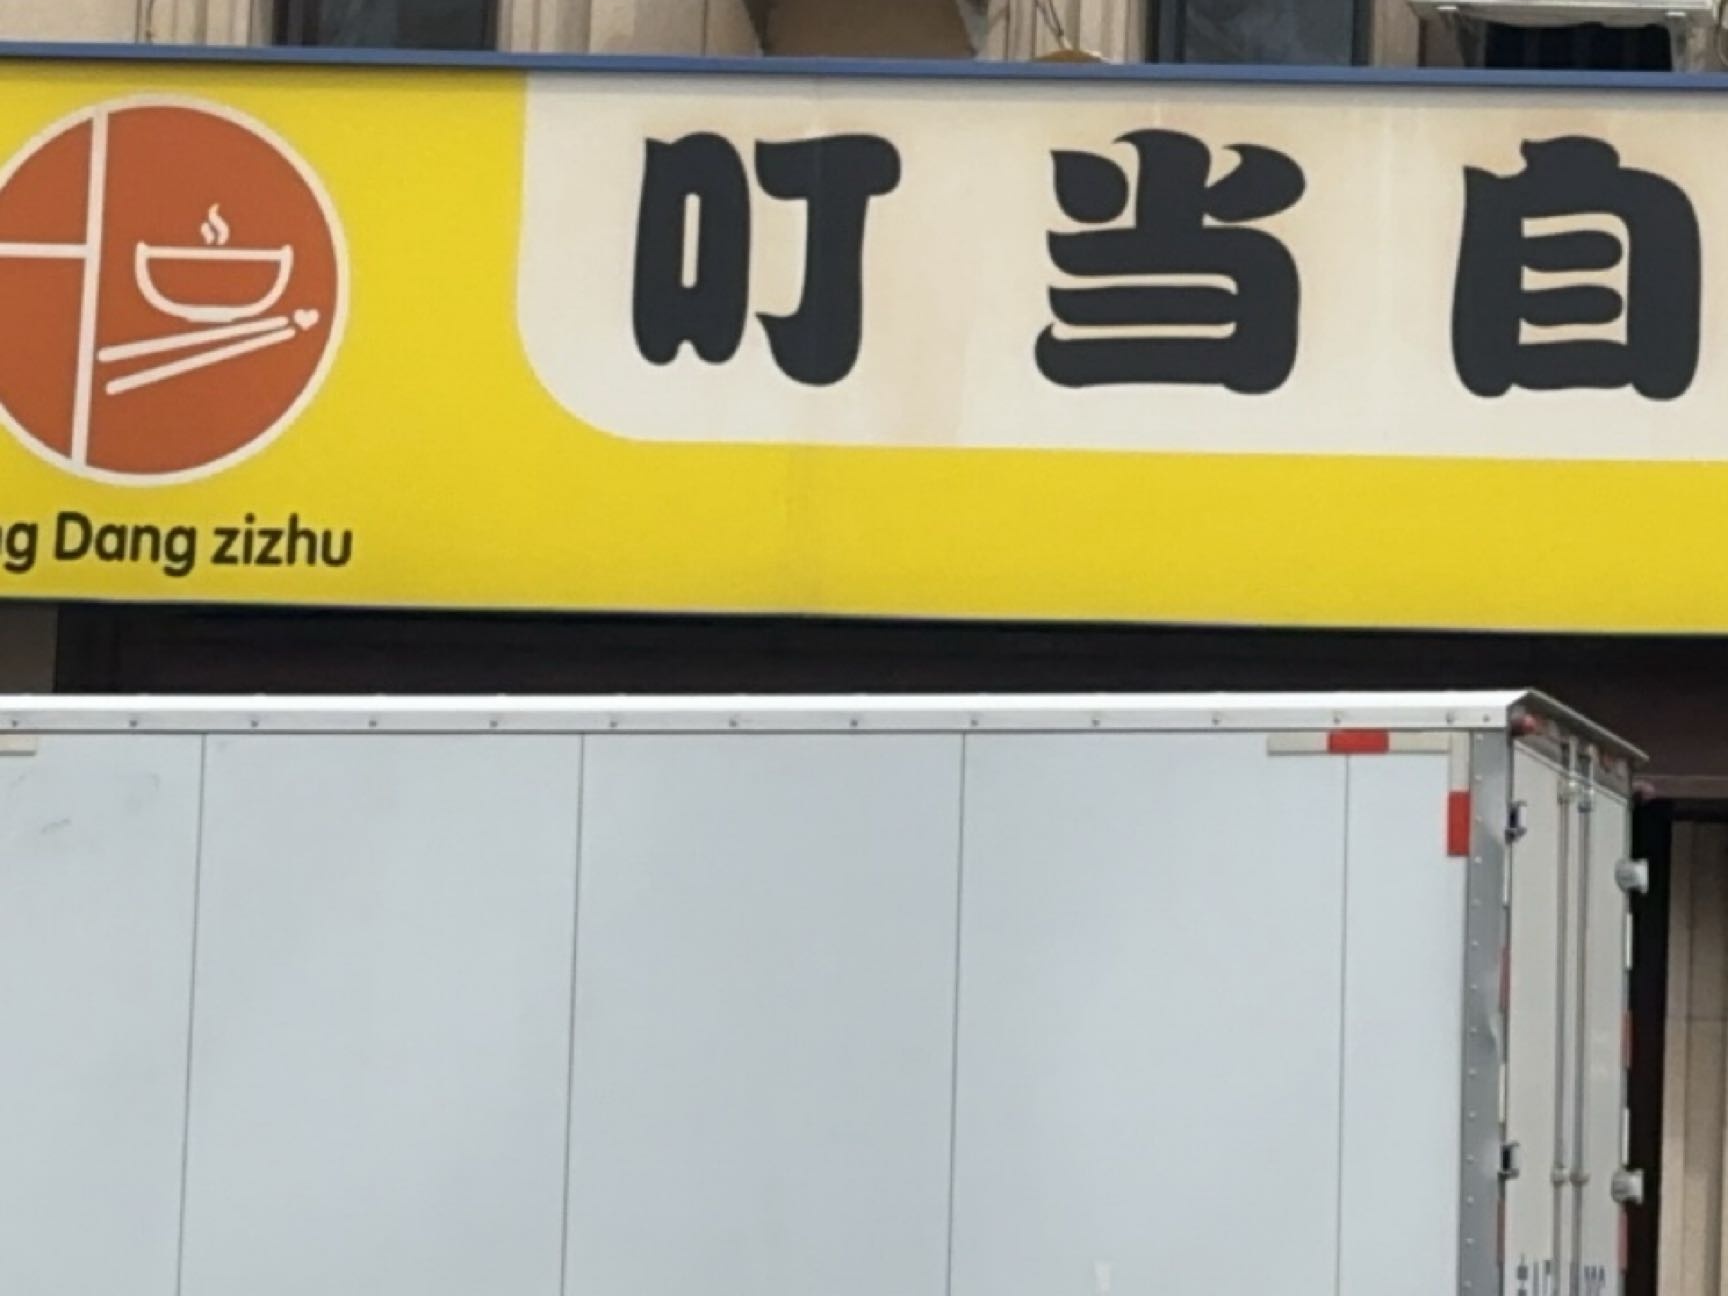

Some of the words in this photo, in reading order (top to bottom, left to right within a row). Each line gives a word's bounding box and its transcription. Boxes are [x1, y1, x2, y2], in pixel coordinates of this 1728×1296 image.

[0, 522, 38, 574] g
[54, 510, 197, 577] Dang
[210, 512, 353, 567] zizhu
